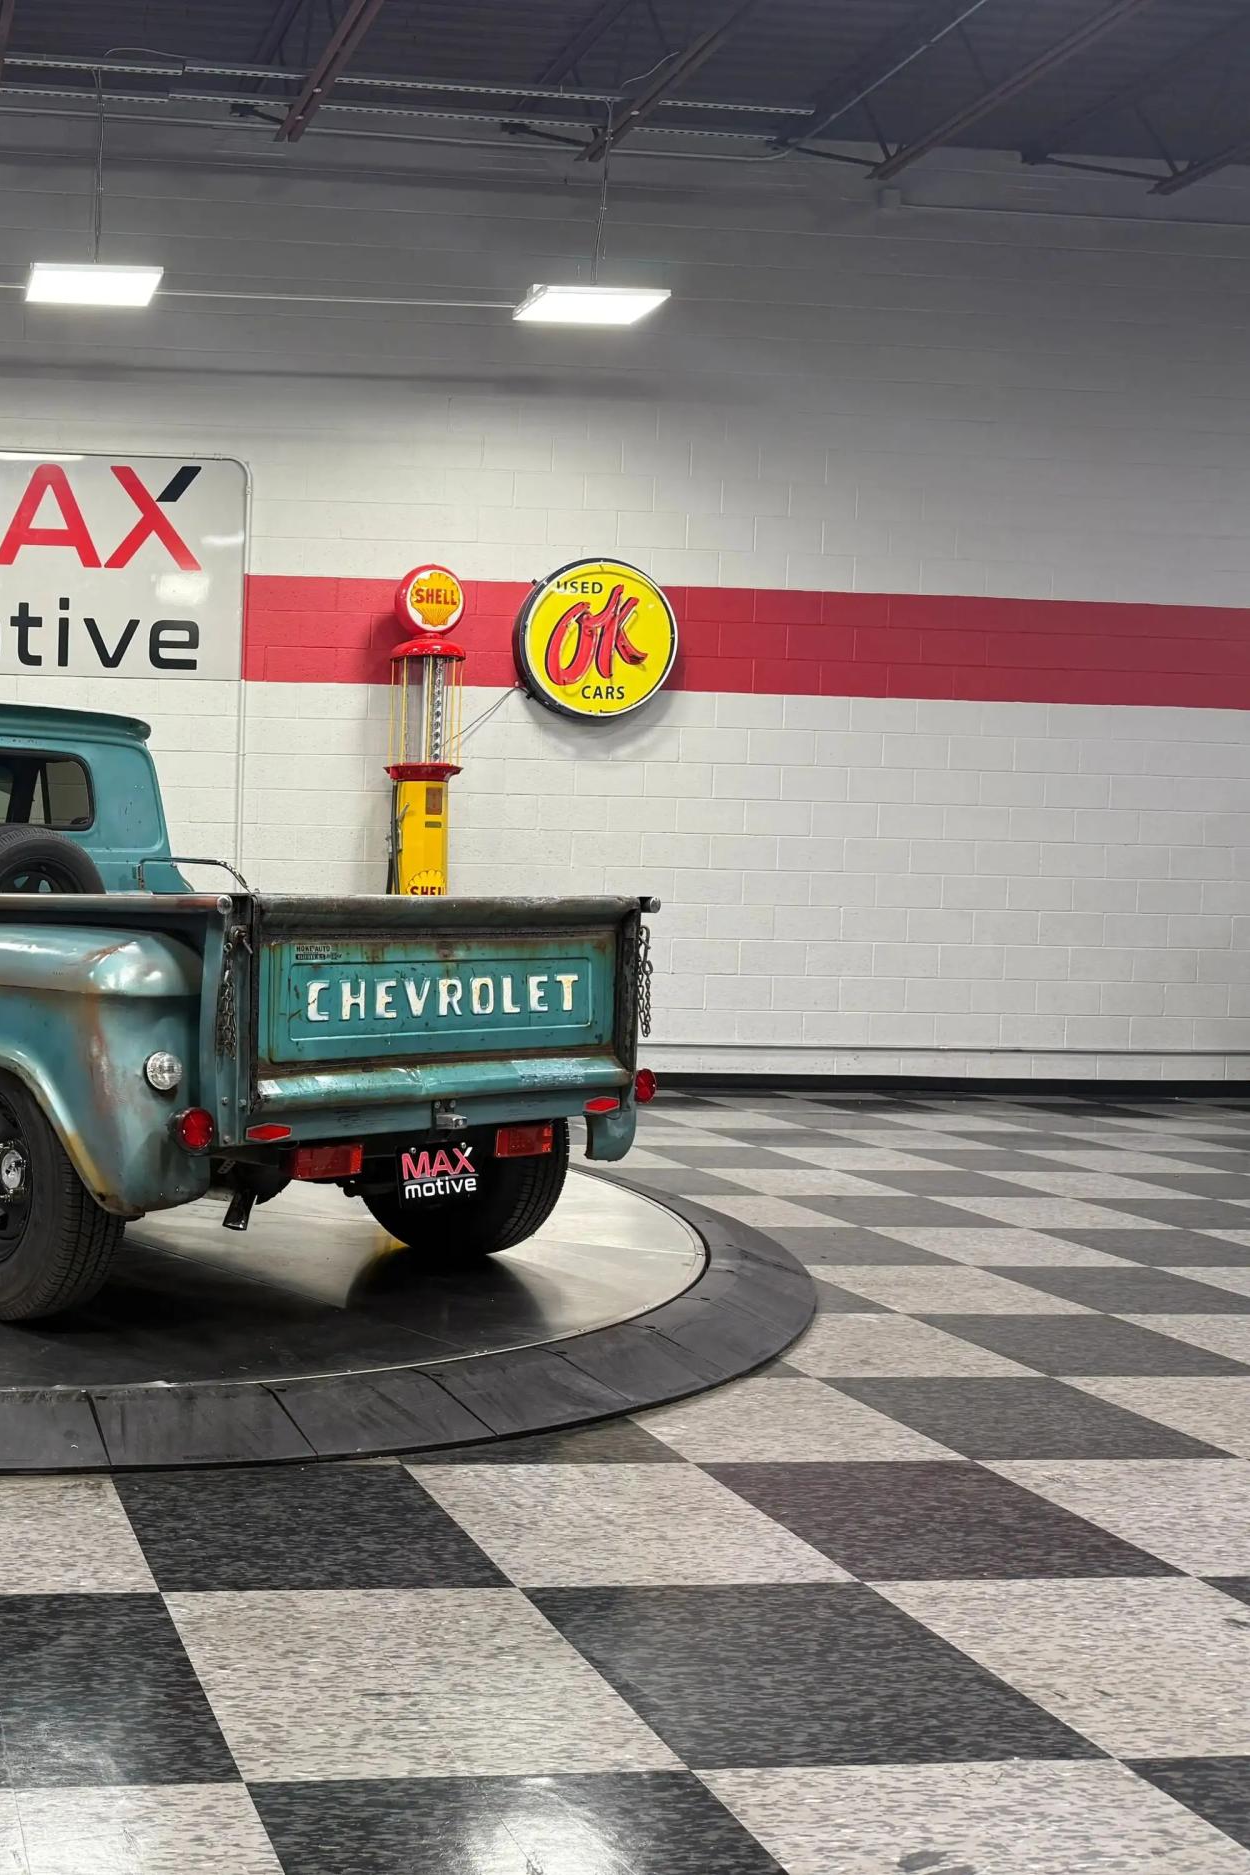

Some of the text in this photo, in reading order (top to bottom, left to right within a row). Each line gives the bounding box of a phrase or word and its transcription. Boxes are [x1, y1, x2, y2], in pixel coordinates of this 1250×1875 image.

[413, 587, 458, 606] SHELL
[556, 581, 603, 594] USED
[545, 584, 648, 686] OK
[581, 685, 625, 699] CARS
[306, 973, 579, 1022] CHEVROLET
[401, 1147, 476, 1180] MAX
[404, 1176, 477, 1199] motive
